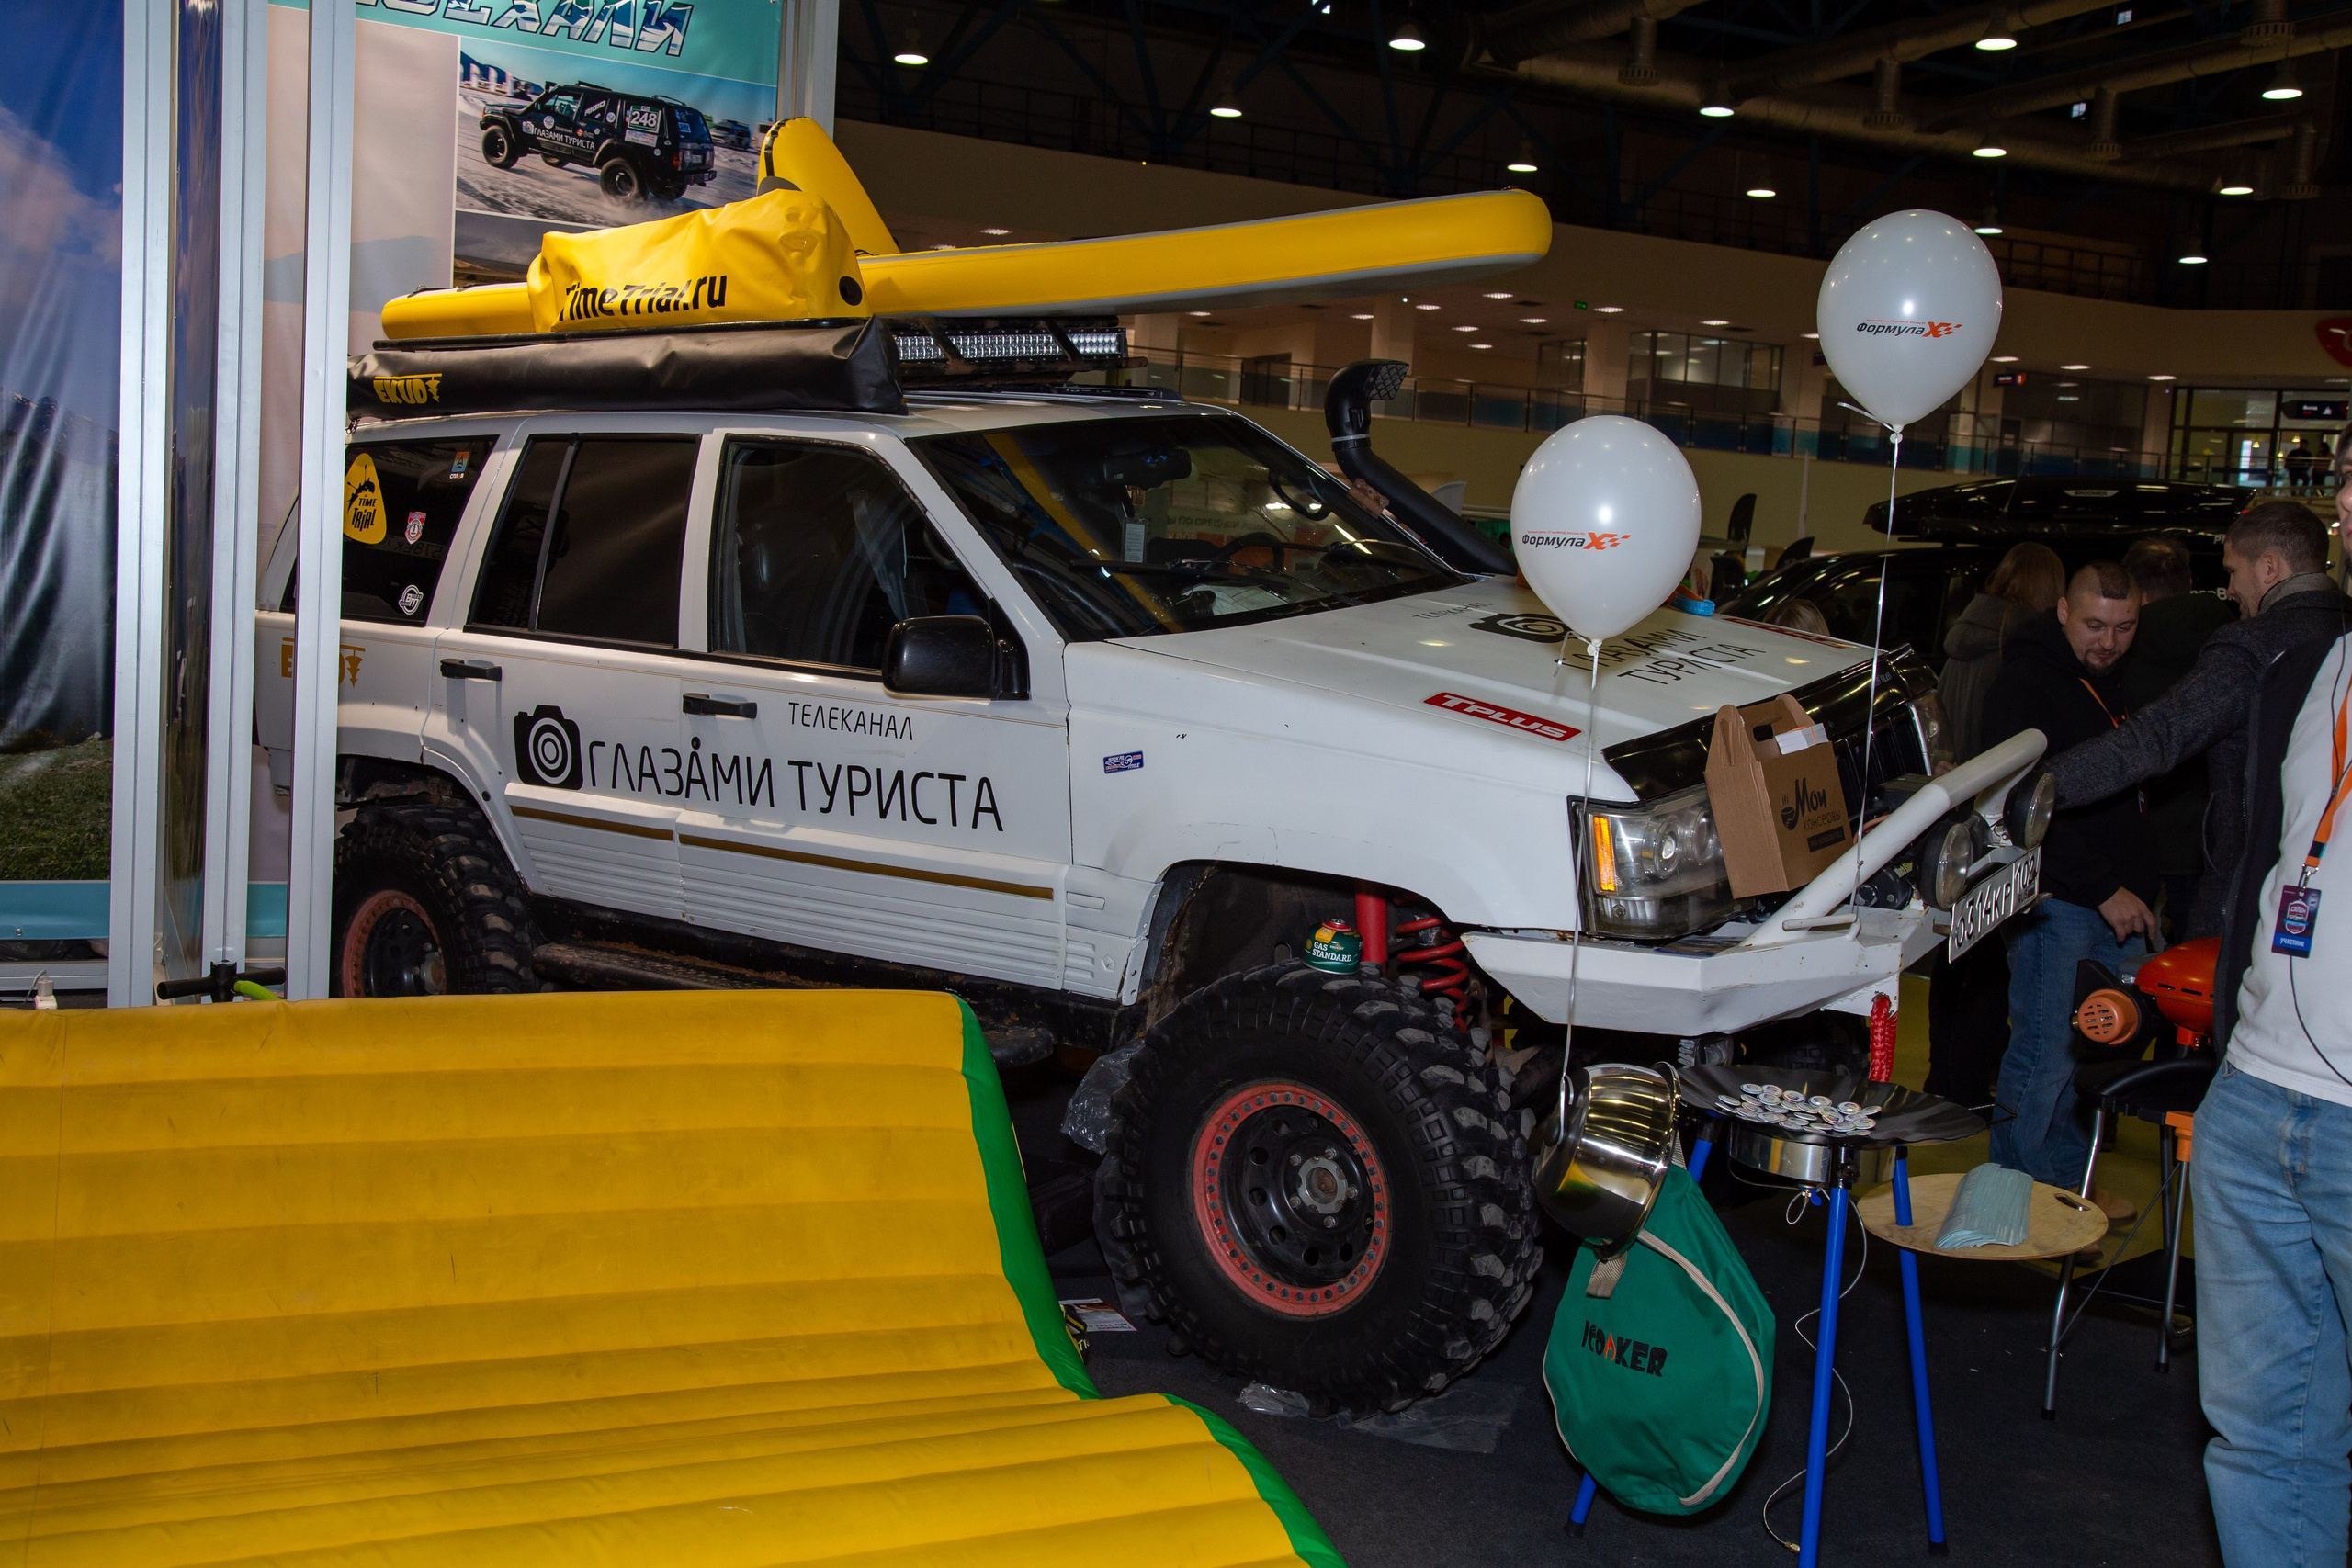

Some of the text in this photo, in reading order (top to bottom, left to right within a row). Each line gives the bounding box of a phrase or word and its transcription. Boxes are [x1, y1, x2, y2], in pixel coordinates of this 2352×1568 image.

[631, 111, 658, 127] 248
[534, 127, 564, 142] ГЛАЗАМИ
[564, 134, 595, 150] ТУРИСТА
[788, 701, 914, 741] ТЕЛЕКАНАЛ
[588, 739, 1004, 832] ГЛАЗАМИ ТУРИСТА
[1312, 948, 1352, 963] STANDARD
[1313, 941, 1329, 952] GAS
